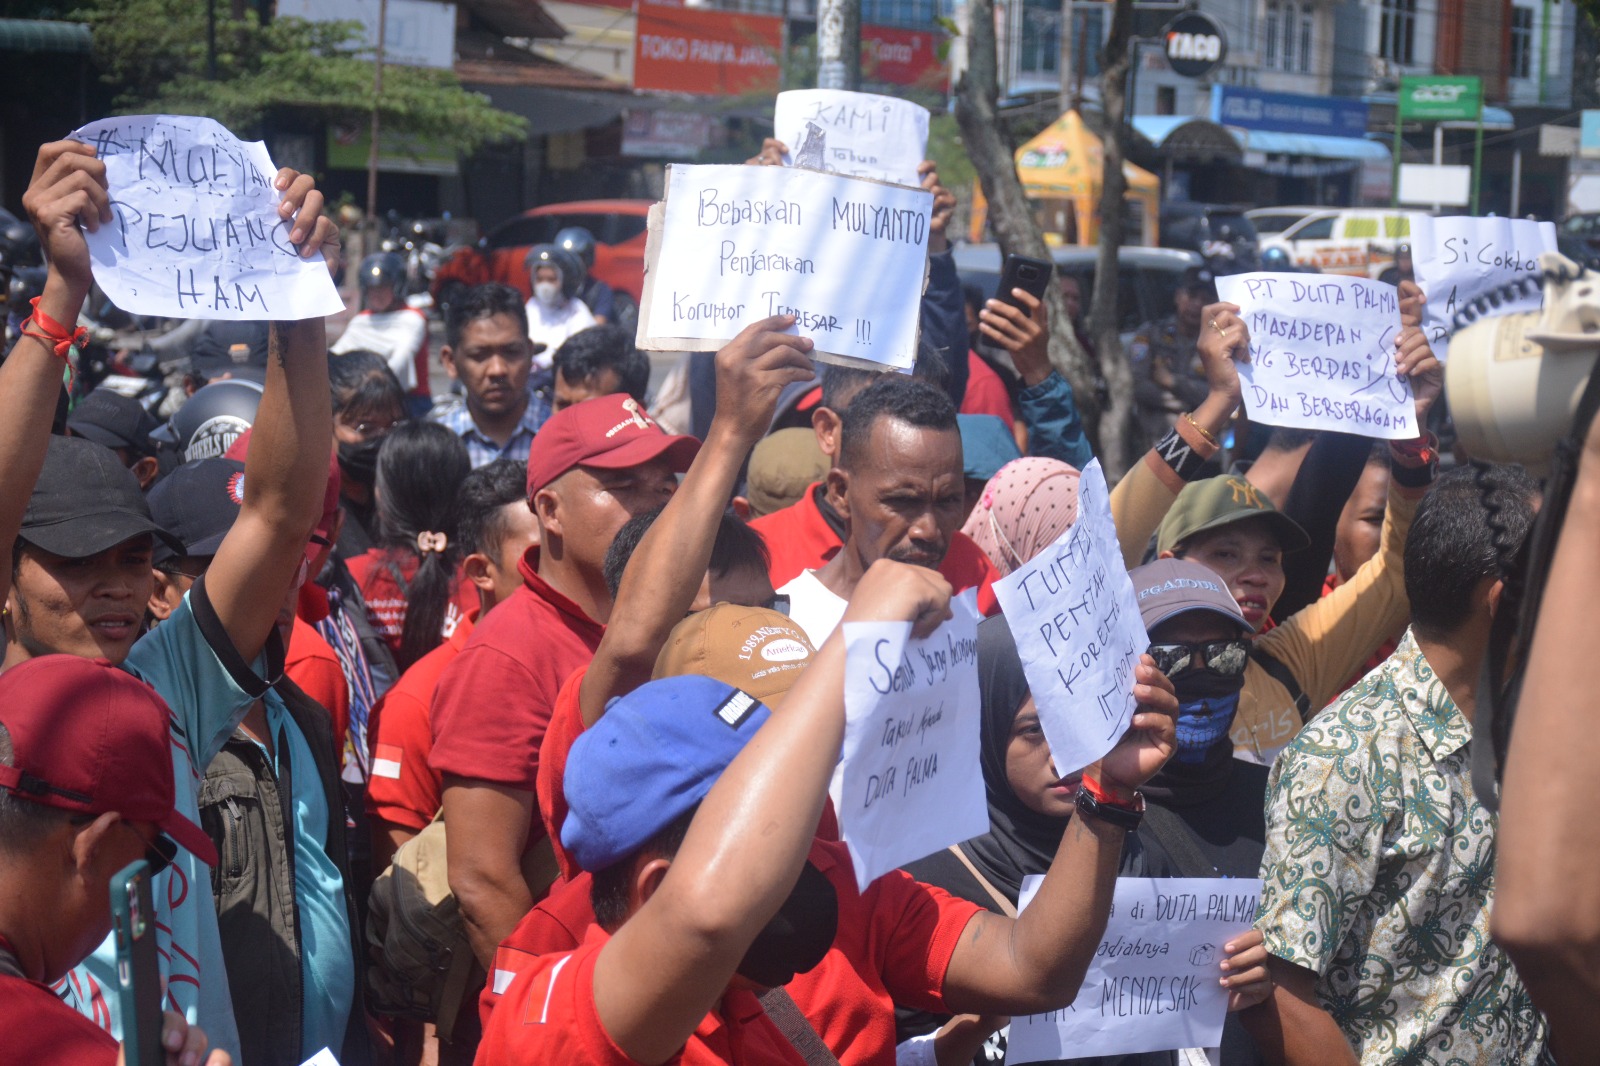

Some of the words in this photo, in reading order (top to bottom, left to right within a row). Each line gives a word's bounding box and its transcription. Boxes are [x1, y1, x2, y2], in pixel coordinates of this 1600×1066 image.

[641, 34, 688, 61] TOKO
[1167, 32, 1221, 61] TACO
[697, 188, 802, 227] Bebaskan
[832, 196, 925, 246] MULYANTO
[719, 239, 815, 277] Penjarakan
[672, 290, 746, 327] Koruptor
[1290, 280, 1345, 304] DUTA
[1350, 283, 1397, 314] PALMA
[1253, 313, 1362, 346] MASADEPAN
[1250, 384, 1290, 411] DAN
[1300, 392, 1407, 431] BERSERAGAM
[863, 766, 896, 809] DUTA
[902, 752, 938, 797] PALMA
[1130, 901, 1145, 920] di
[1155, 893, 1198, 922] DUTA
[1205, 893, 1257, 923] PALMA
[1096, 935, 1170, 959] adiahnya
[1100, 975, 1201, 1018] MENDESAK
